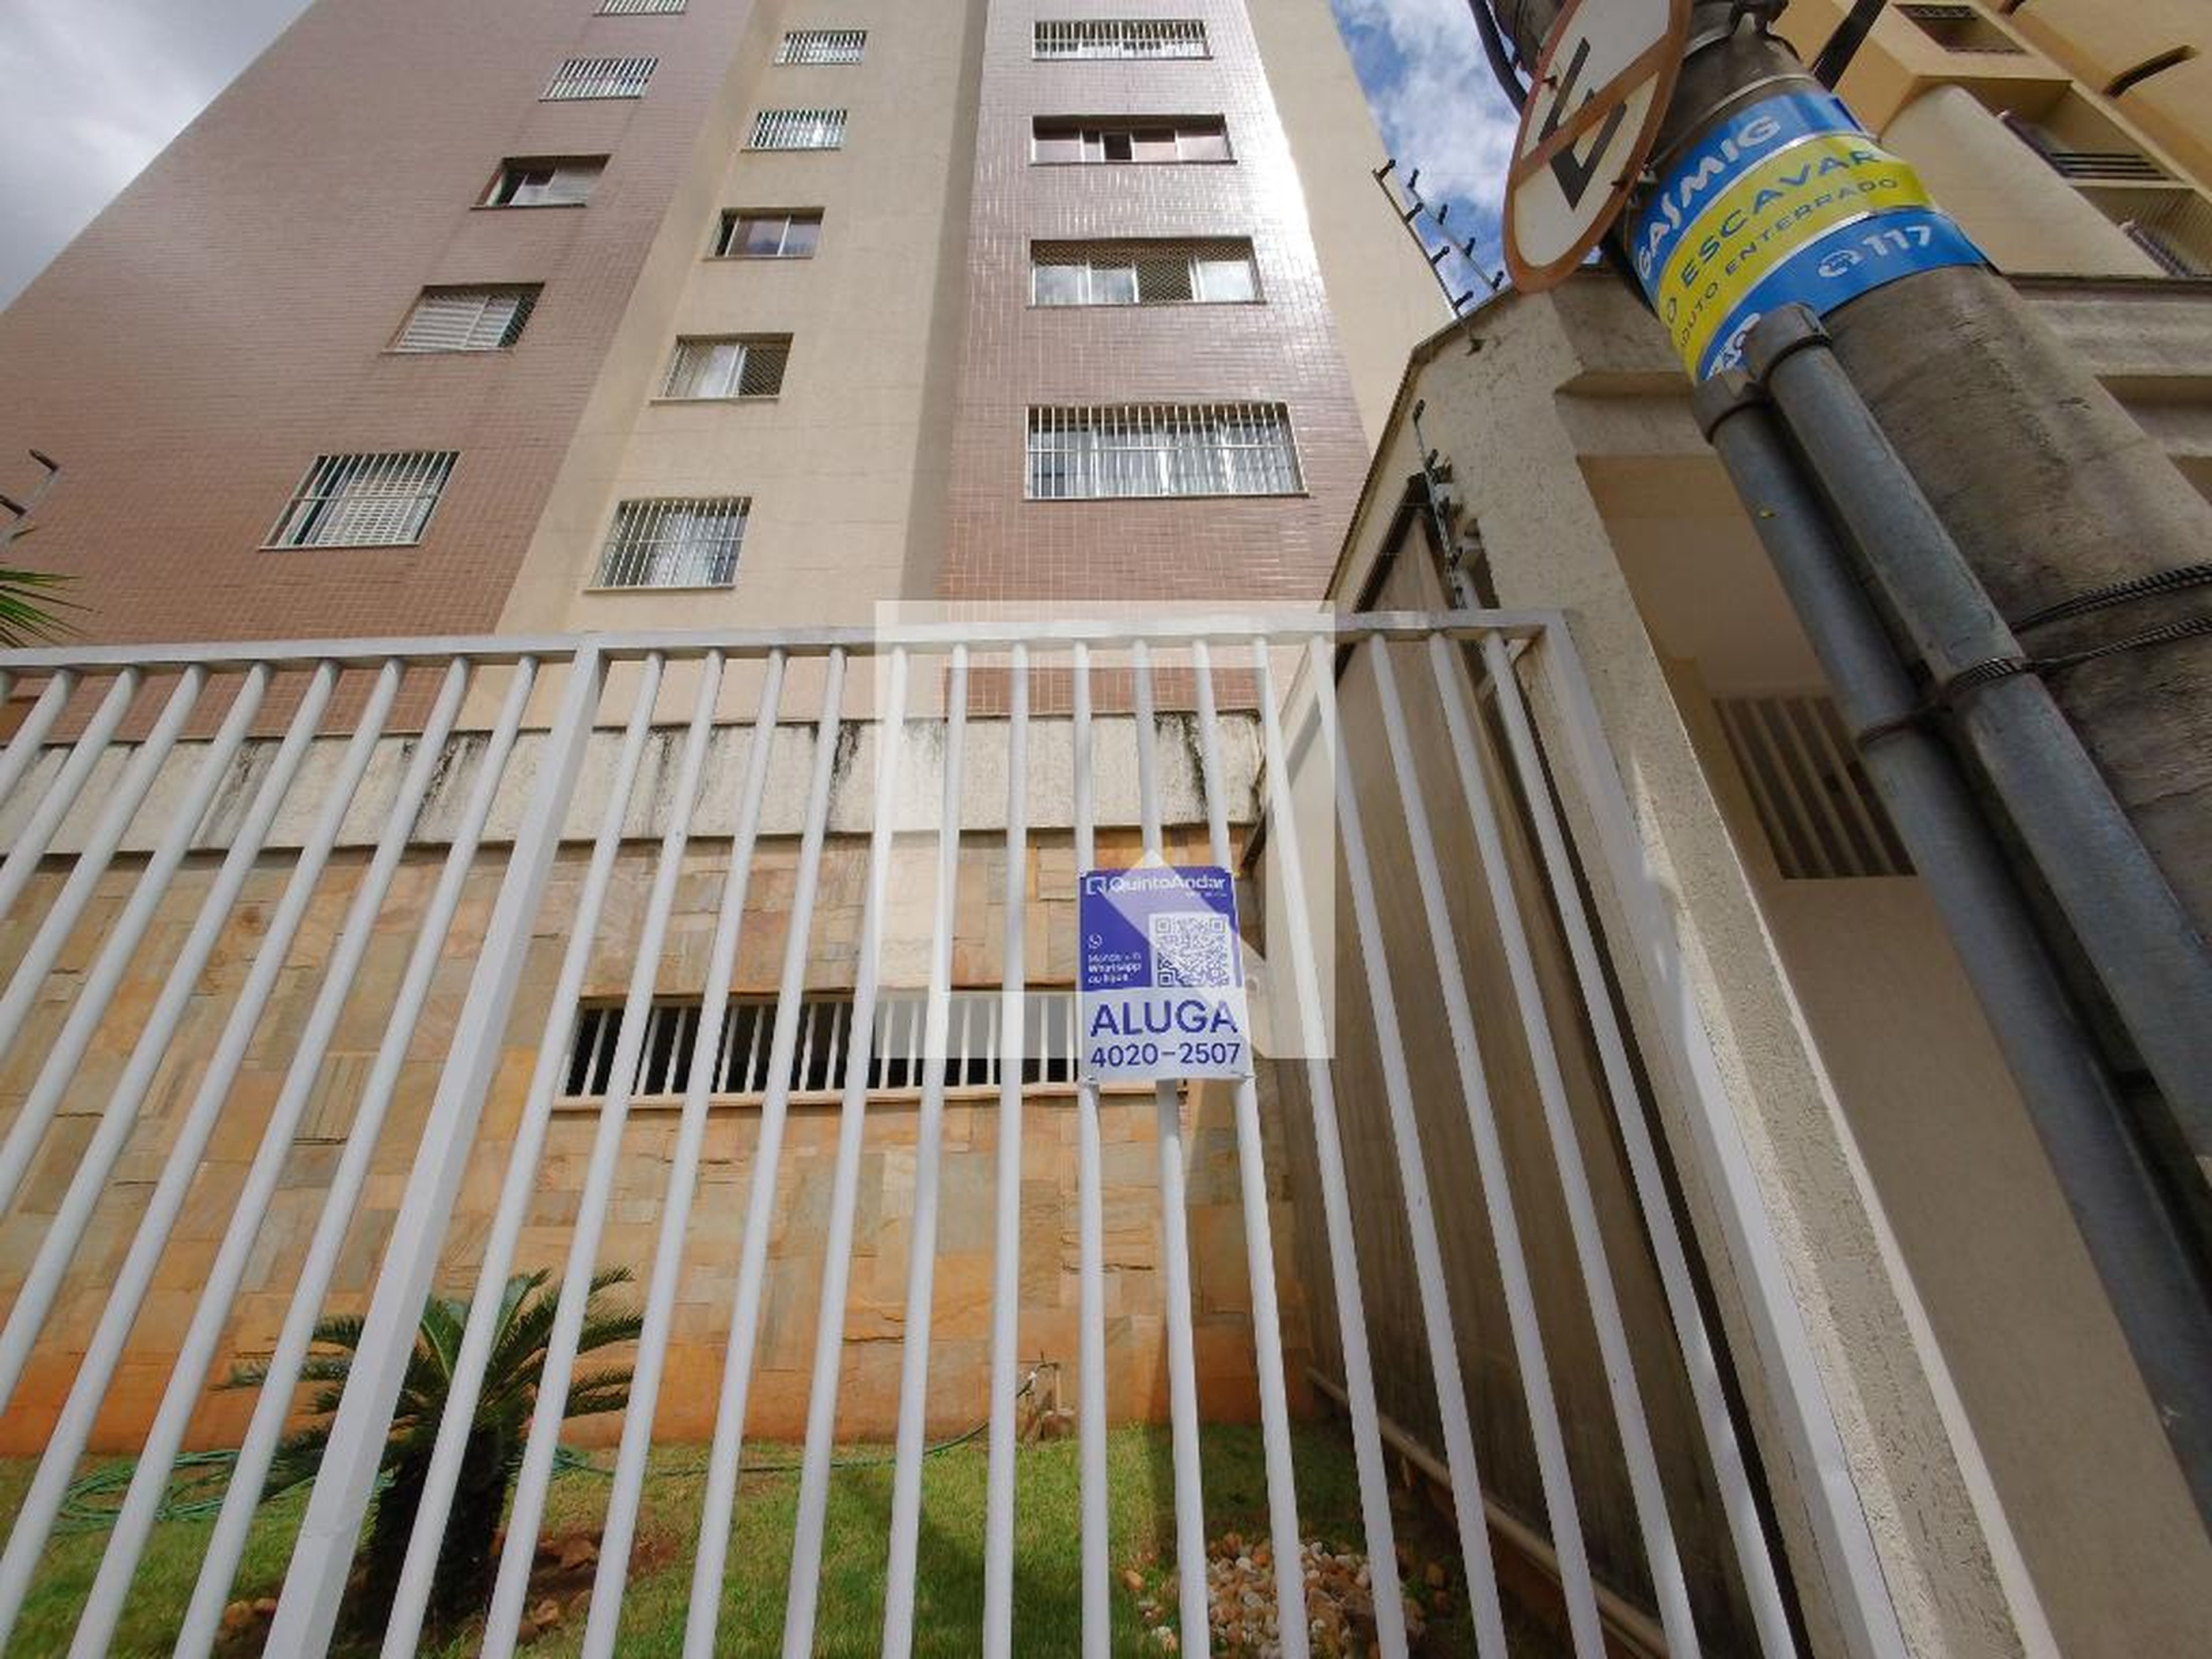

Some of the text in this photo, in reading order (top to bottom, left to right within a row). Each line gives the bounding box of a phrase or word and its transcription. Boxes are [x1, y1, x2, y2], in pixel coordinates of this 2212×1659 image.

[1638, 116, 1781, 281] GASMIG
[1680, 151, 1881, 288] ESCAVAR
[1725, 178, 1897, 276] ENTERRADO
[1861, 225, 1932, 256] 117
[1090, 999, 1238, 1037] ALUGA
[1090, 1043, 1241, 1067] 4020-2507
